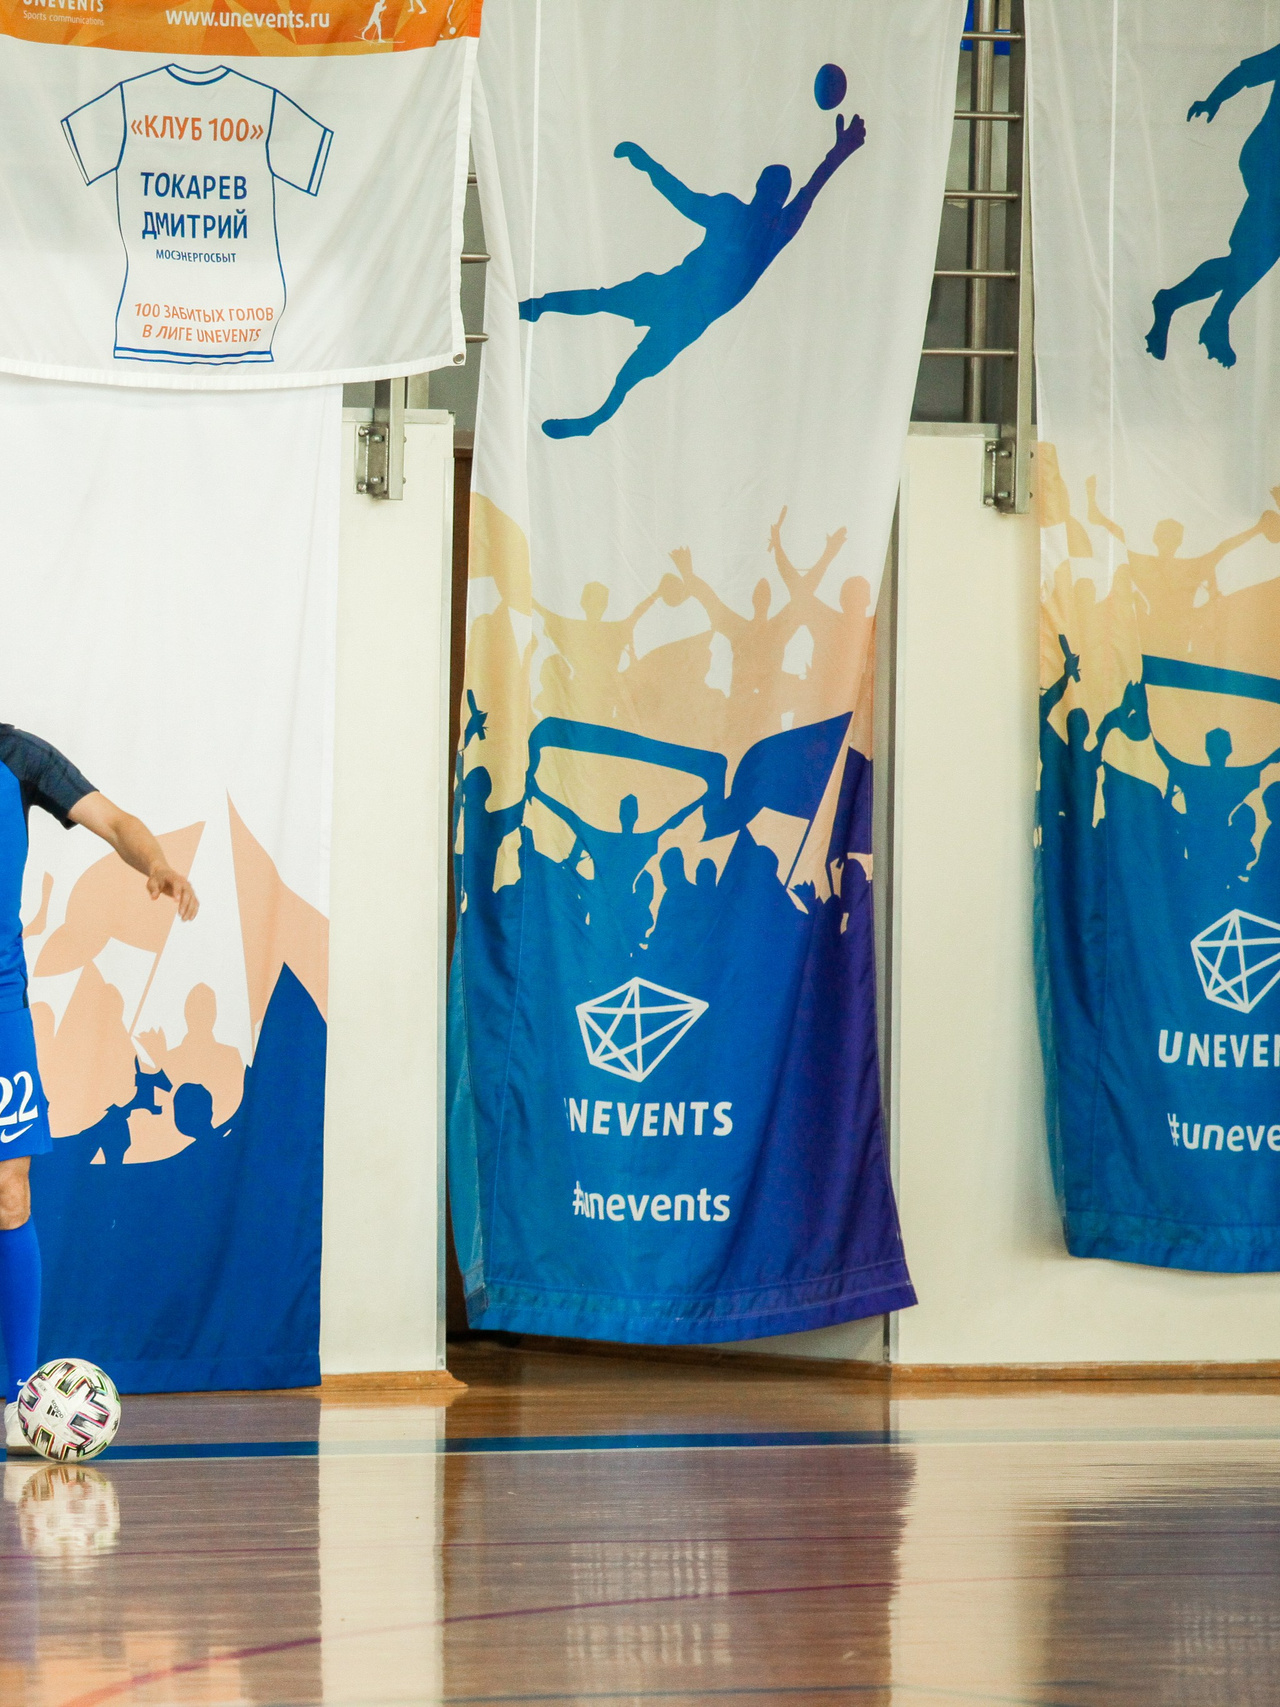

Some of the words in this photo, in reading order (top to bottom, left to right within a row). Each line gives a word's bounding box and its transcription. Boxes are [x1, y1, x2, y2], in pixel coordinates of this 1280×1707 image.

[23, 9, 47, 21] Sports
[48, 13, 105, 27] communications
[165, 9, 330, 29] www.unevents.ru
[130, 114, 203, 142] «КЛУБ
[208, 117, 264, 143] 100»
[140, 171, 248, 200] ТОКАРЕВ
[141, 208, 248, 240] ДМИТРИЙ
[155, 248, 237, 263] МОСЭНЕРГОСБЫТ
[136, 302, 161, 318] 100
[163, 304, 225, 323] ЗАБИТЫХ
[228, 306, 274, 322] ГОЛОВ
[142, 324, 153, 338] В
[155, 325, 193, 342] ЛИГЕ
[196, 328, 262, 344] UNEVENTS
[1158, 1028, 1280, 1068] UNEVE
[563, 1097, 733, 1137] NEVENTS
